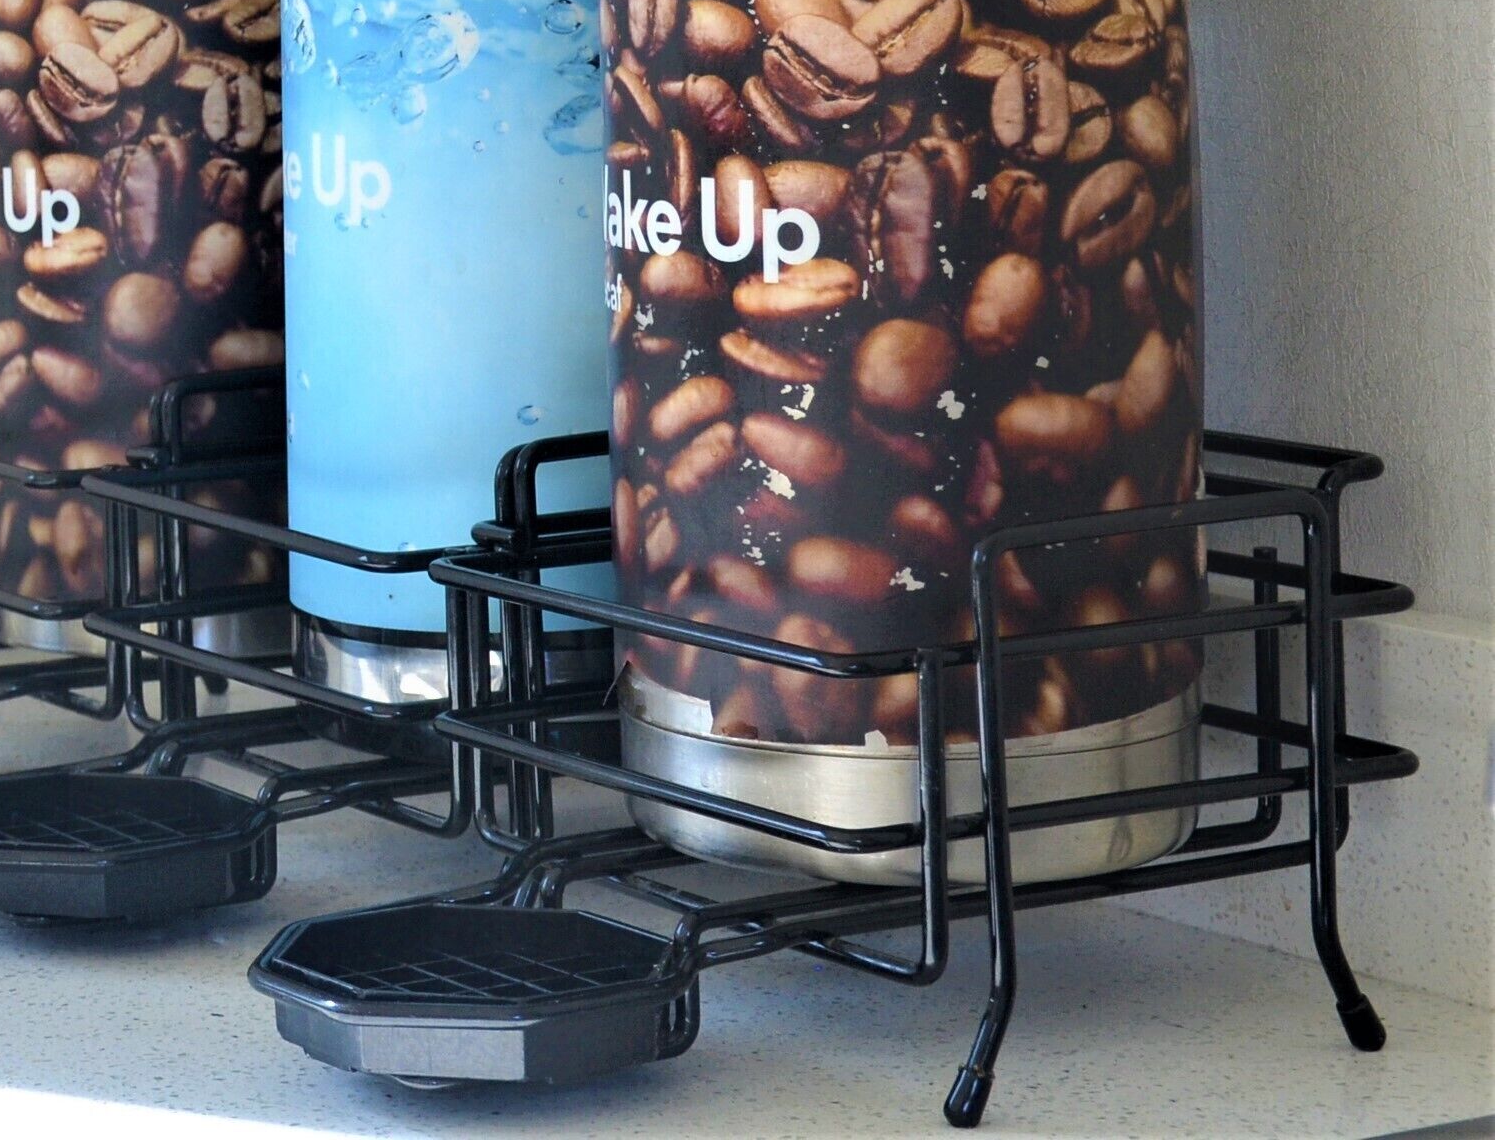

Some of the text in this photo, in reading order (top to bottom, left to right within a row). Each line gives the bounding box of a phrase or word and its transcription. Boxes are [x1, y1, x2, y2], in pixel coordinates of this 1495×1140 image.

[2, 166, 81, 248] Up
[311, 131, 392, 227] Up
[602, 164, 821, 284] ake Up
